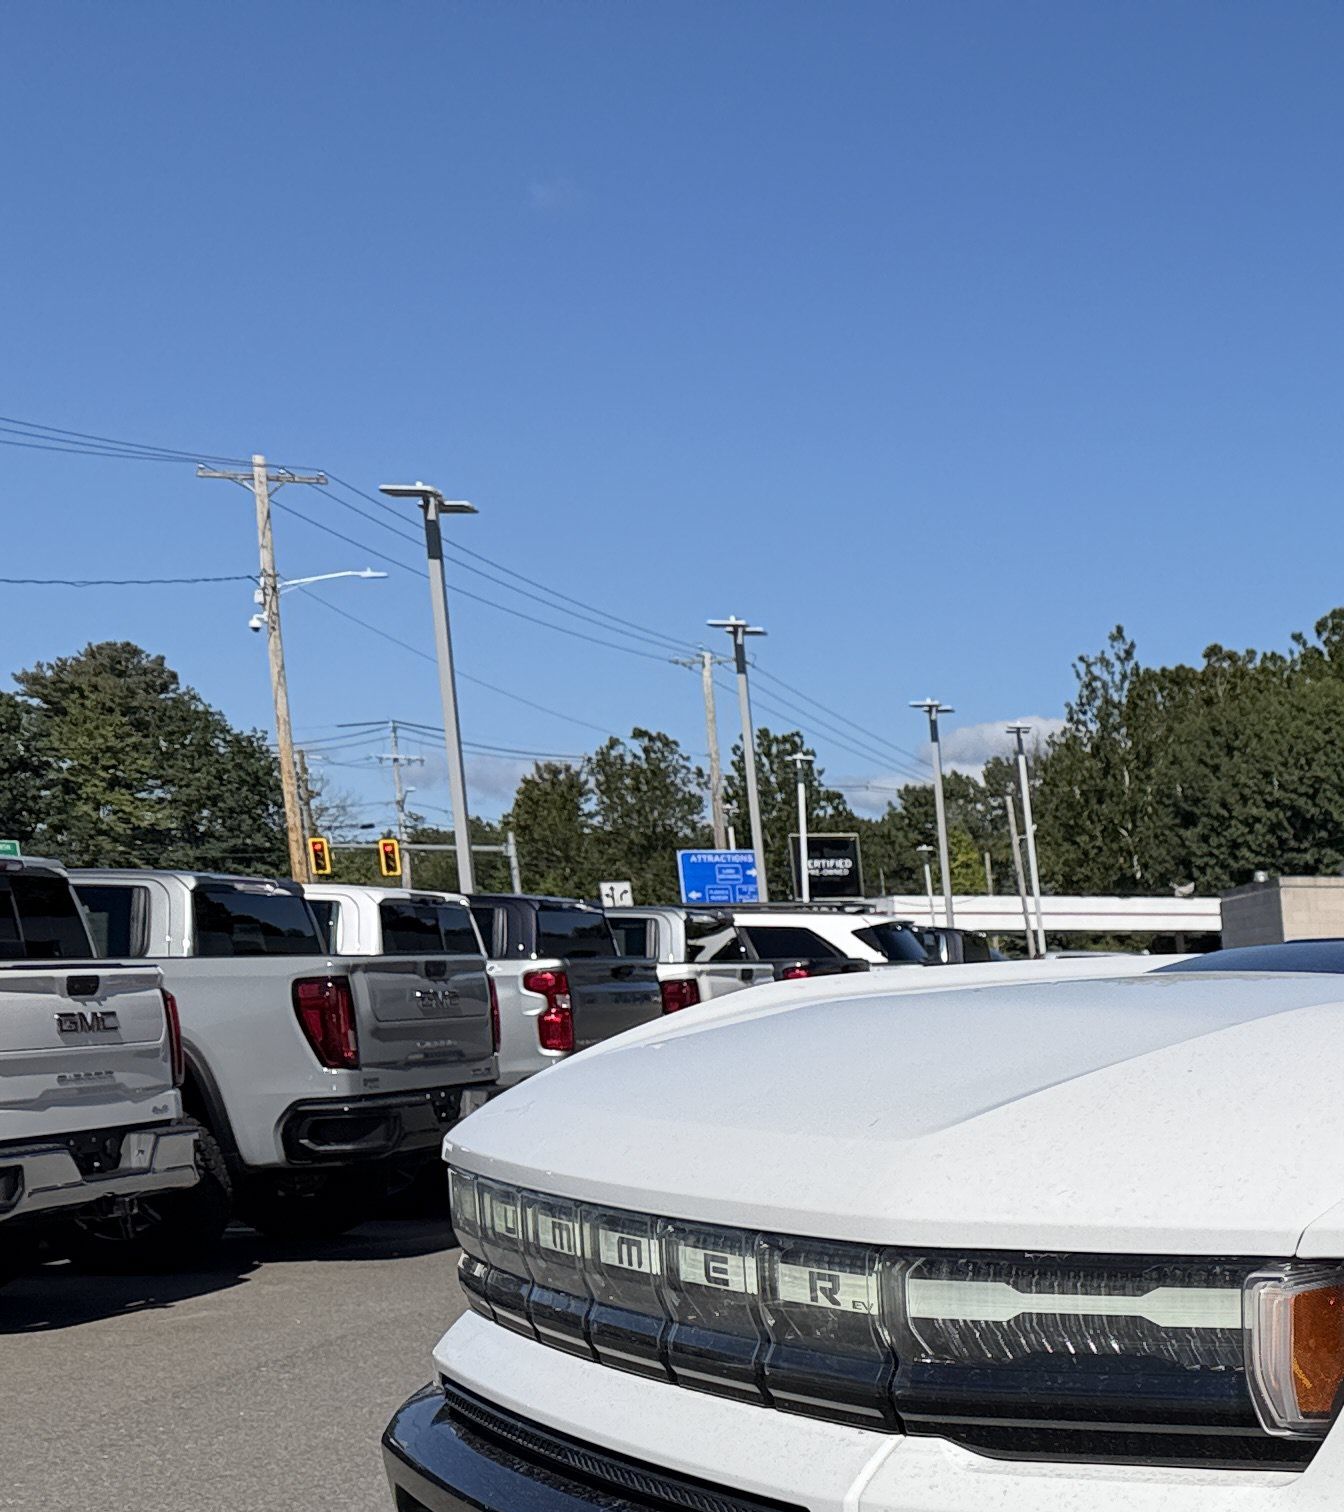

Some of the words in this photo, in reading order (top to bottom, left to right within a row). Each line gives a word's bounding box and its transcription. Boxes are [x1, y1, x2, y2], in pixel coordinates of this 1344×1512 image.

[690, 854, 753, 863] ATTRACTIONS
[807, 858, 853, 869] ERTIFIED
[55, 1011, 119, 1033] GMC
[503, 1204, 842, 1307] UMMER
